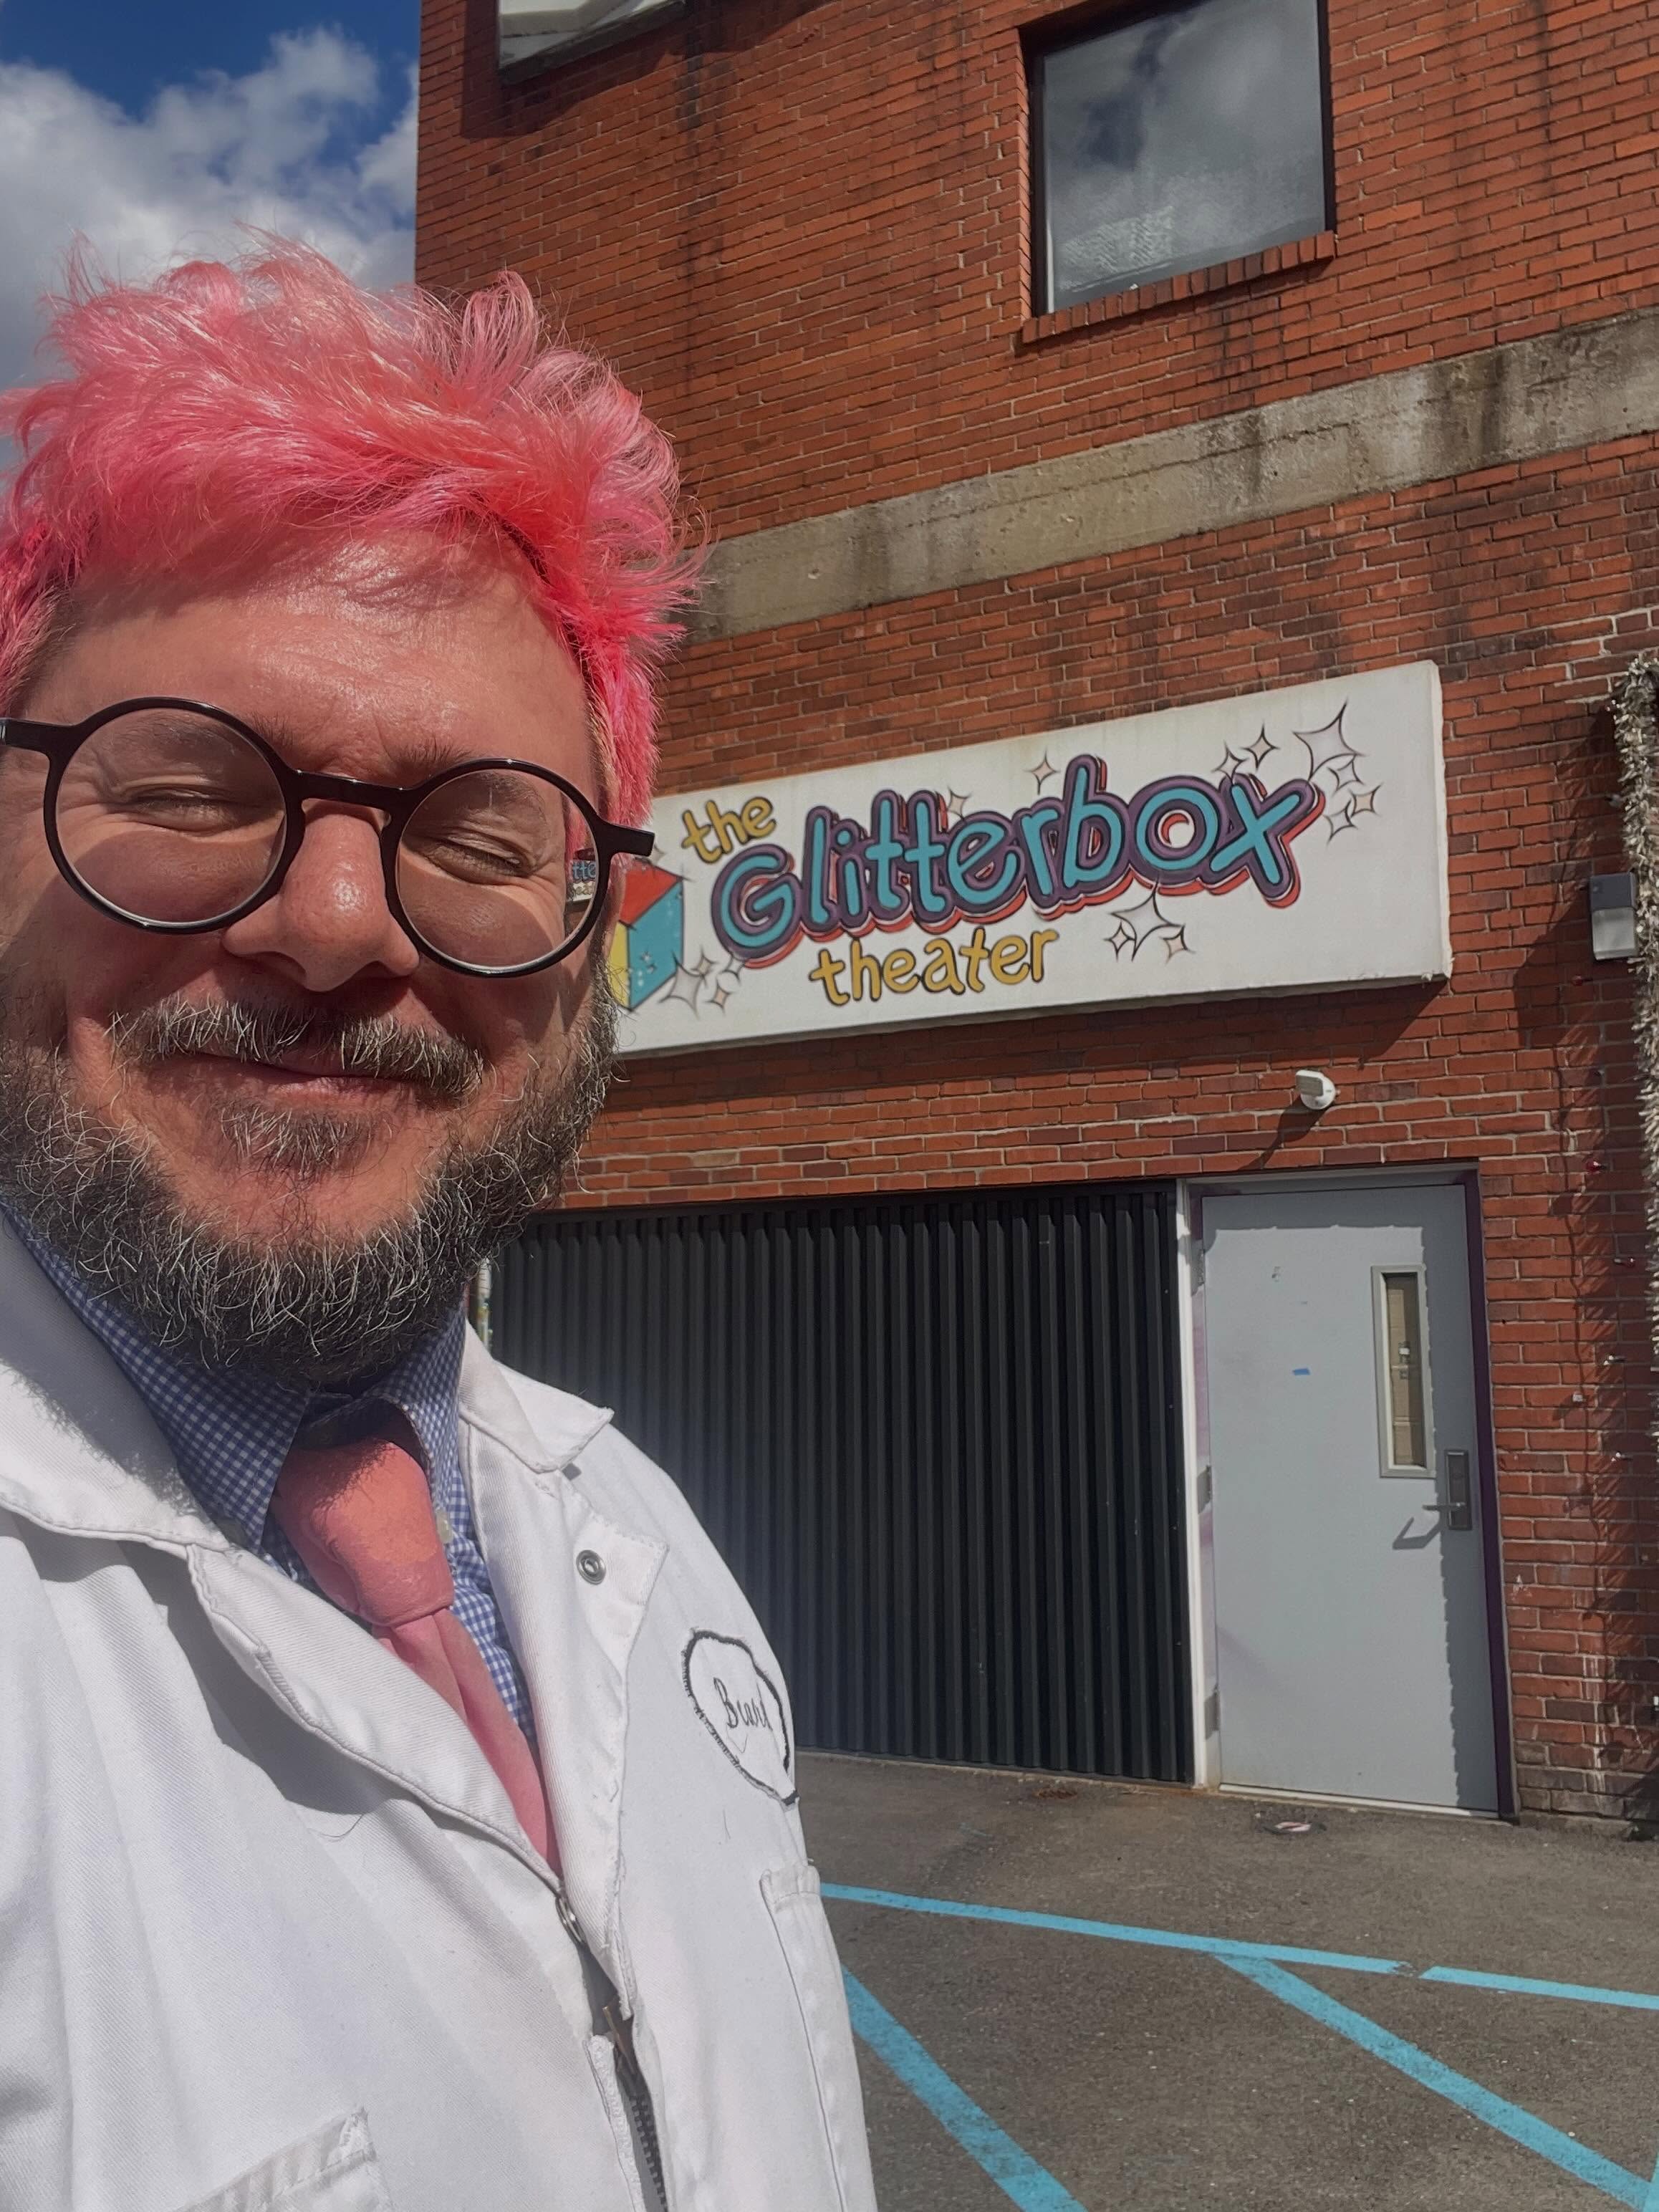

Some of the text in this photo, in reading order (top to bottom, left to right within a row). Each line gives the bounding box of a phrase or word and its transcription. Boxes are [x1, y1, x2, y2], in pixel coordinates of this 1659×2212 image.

[682, 796, 776, 864] the
[711, 754, 1324, 969] Glitterbox
[808, 925, 1059, 1006] theater
